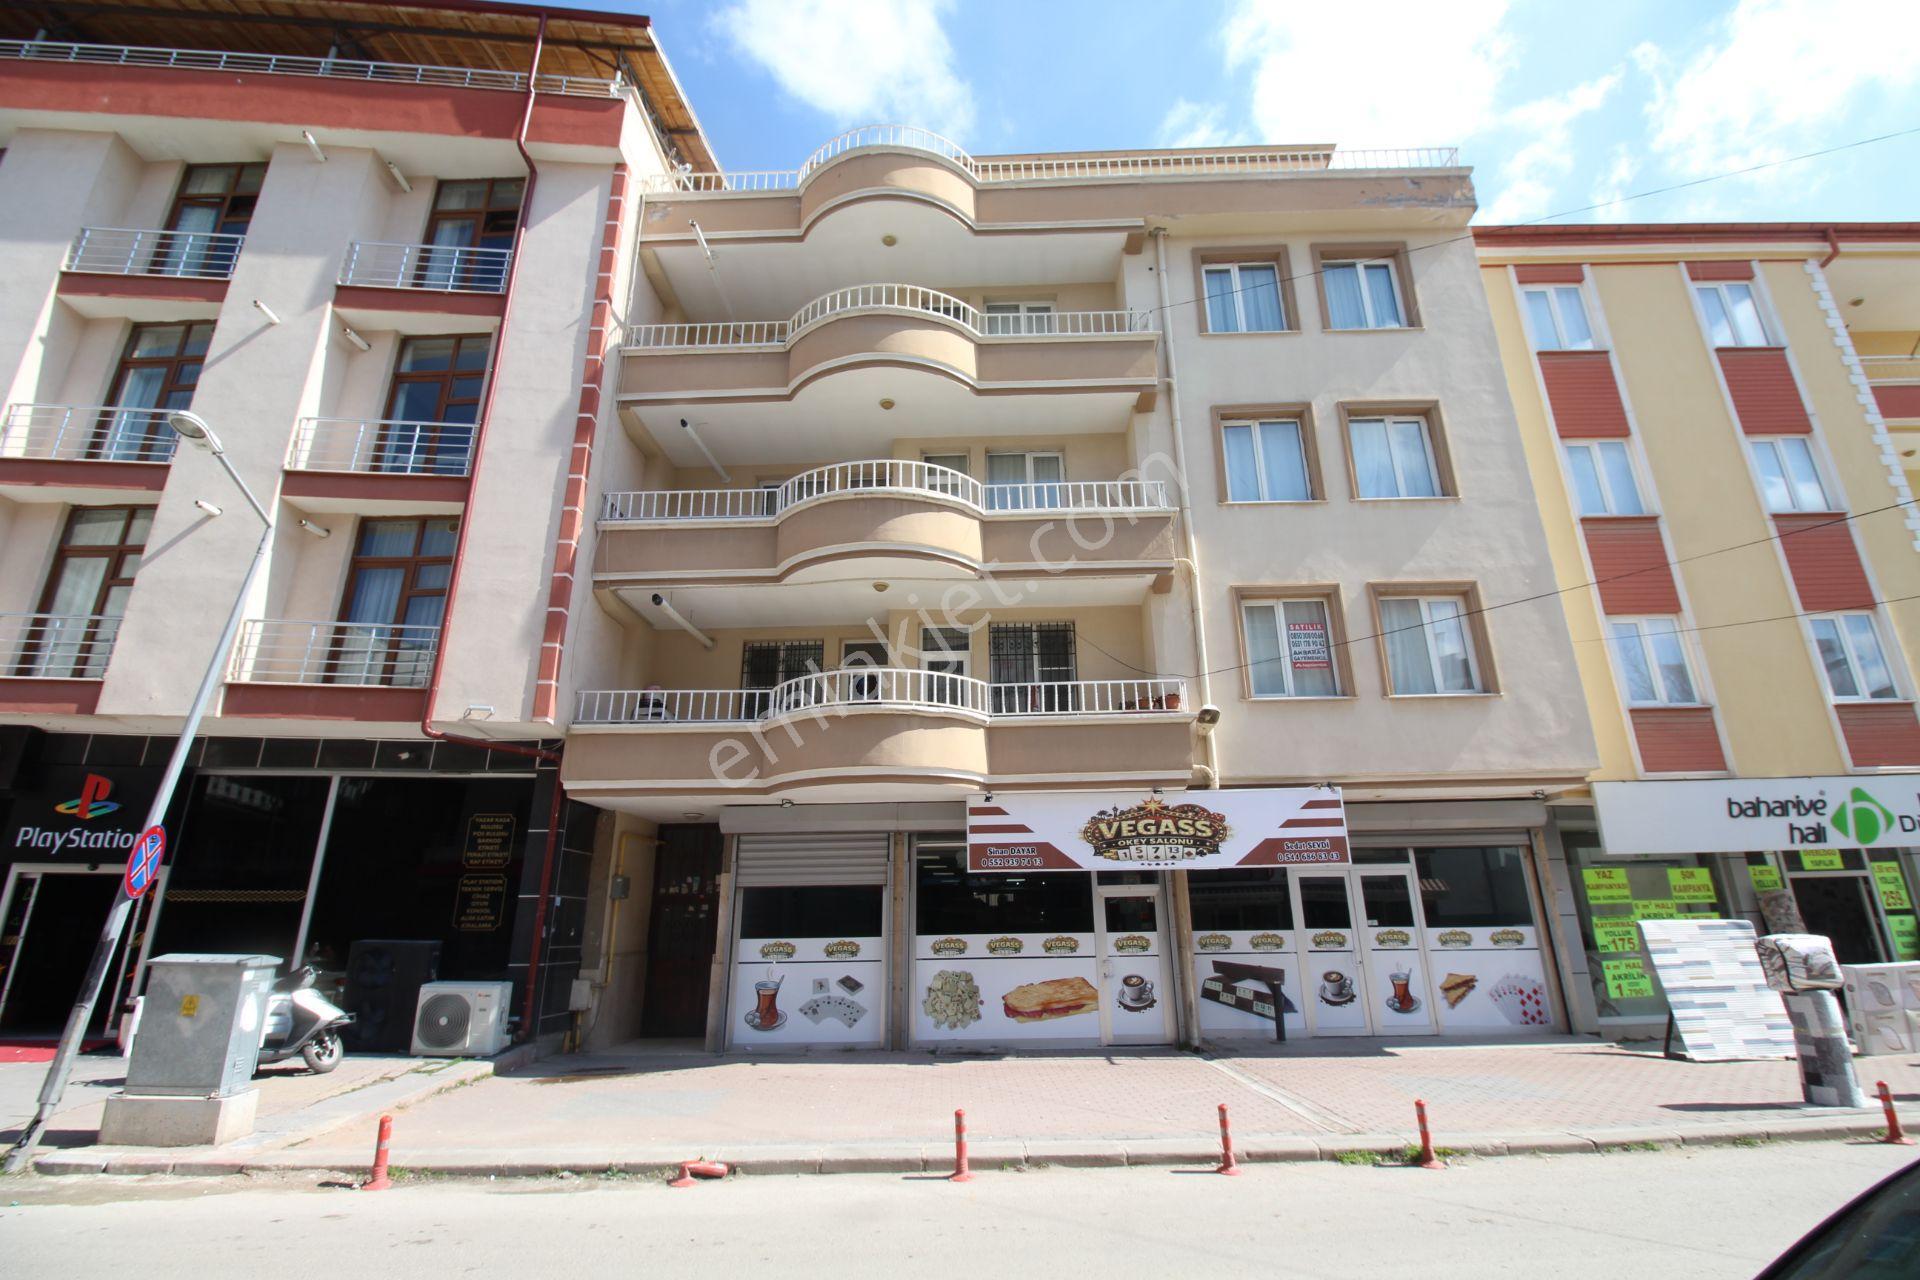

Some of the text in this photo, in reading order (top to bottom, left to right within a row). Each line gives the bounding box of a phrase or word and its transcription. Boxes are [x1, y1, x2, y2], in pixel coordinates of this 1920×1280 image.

[1727, 795, 1828, 818] bahariye
[1098, 819, 1214, 840] VEGASS
[1788, 822, 1828, 844] halı
[1117, 838, 1194, 846] OKEY SALONU
[1284, 841, 1306, 850] Sedat
[988, 847, 1036, 855] Sinan DAYAR
[1135, 846, 1143, 854] 5
[1152, 846, 1160, 854] 7
[1169, 846, 1180, 854] 13
[1594, 870, 1614, 879] YAZ
[1673, 884, 1712, 893] KAMPANYA
[935, 942, 964, 950] VEGASS
[990, 941, 1020, 949] VEGASS
[1117, 940, 1147, 948] VEGASS
[1612, 937, 1636, 951] 175
[1612, 972, 1647, 981] AKRİLİK
